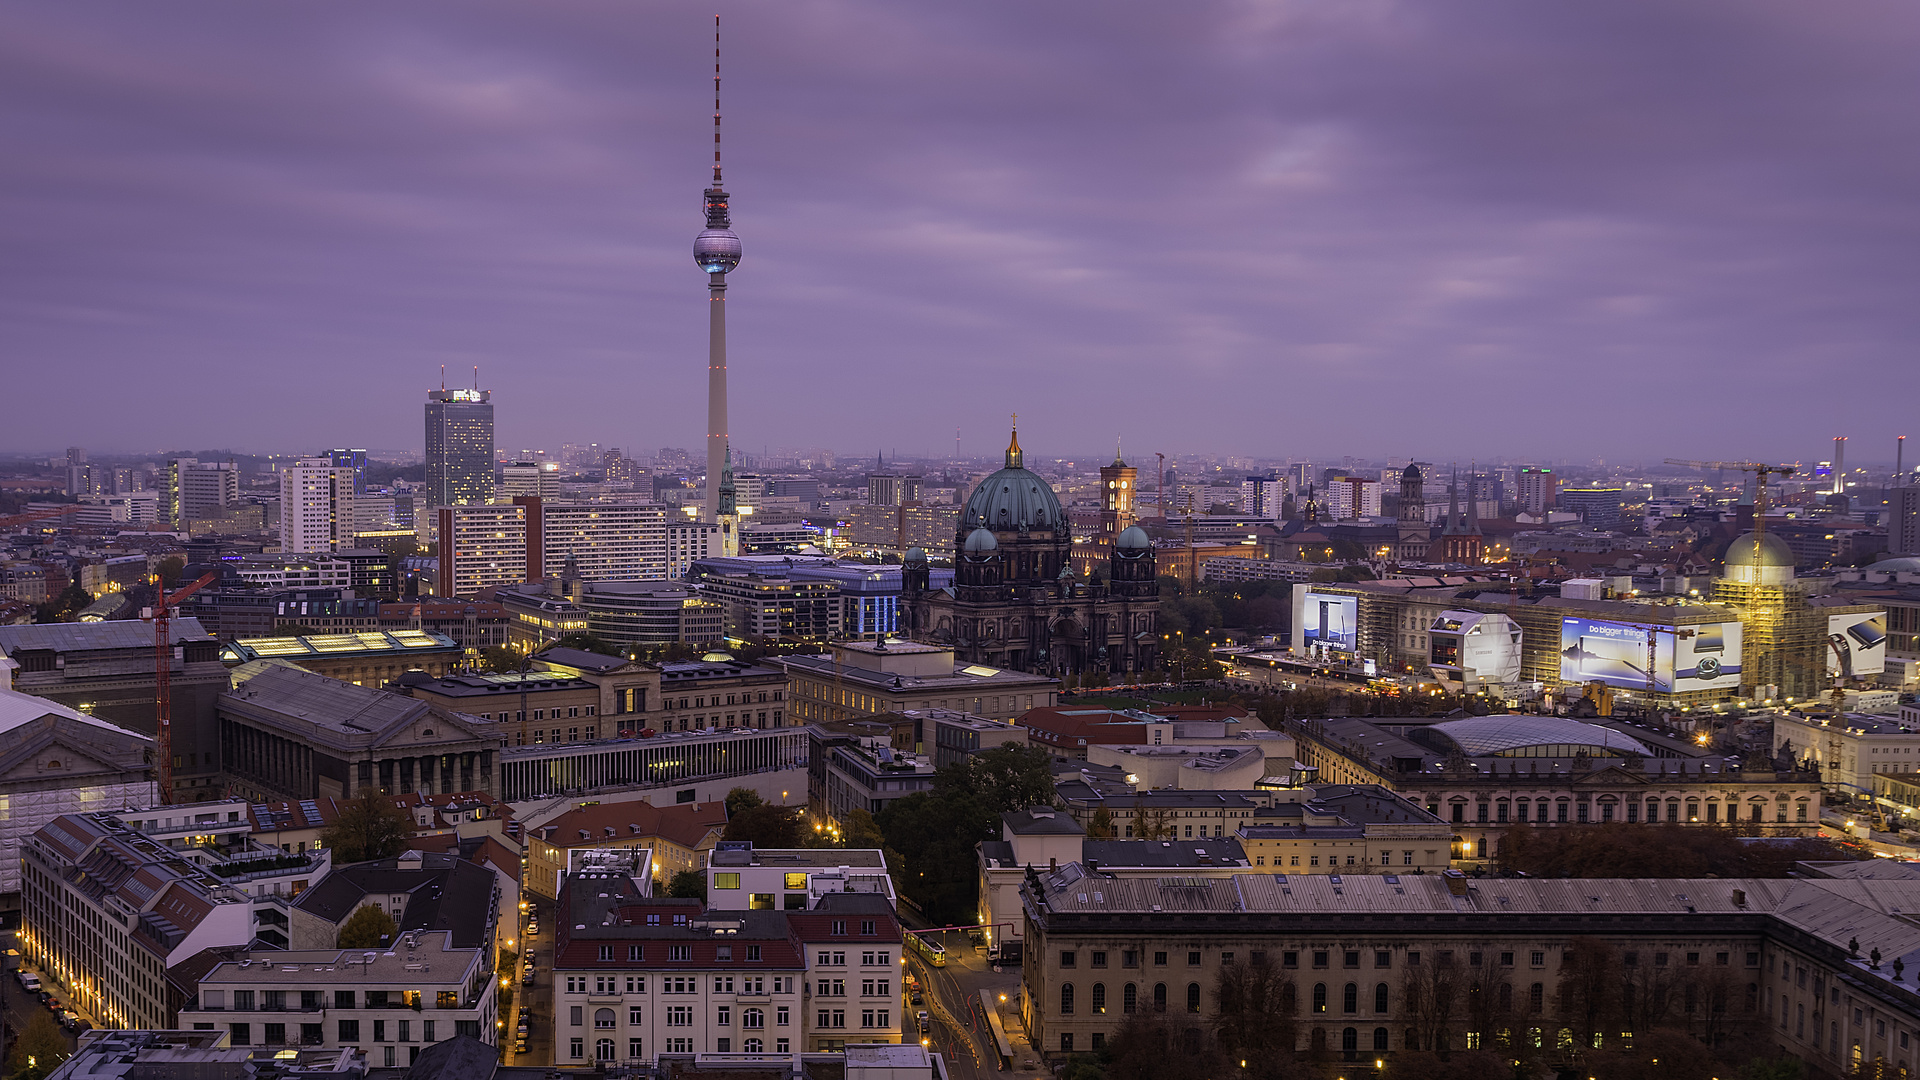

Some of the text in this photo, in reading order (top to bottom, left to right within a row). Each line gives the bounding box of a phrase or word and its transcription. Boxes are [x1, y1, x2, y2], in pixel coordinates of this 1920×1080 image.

[1589, 625, 1645, 638] Do bigger things
